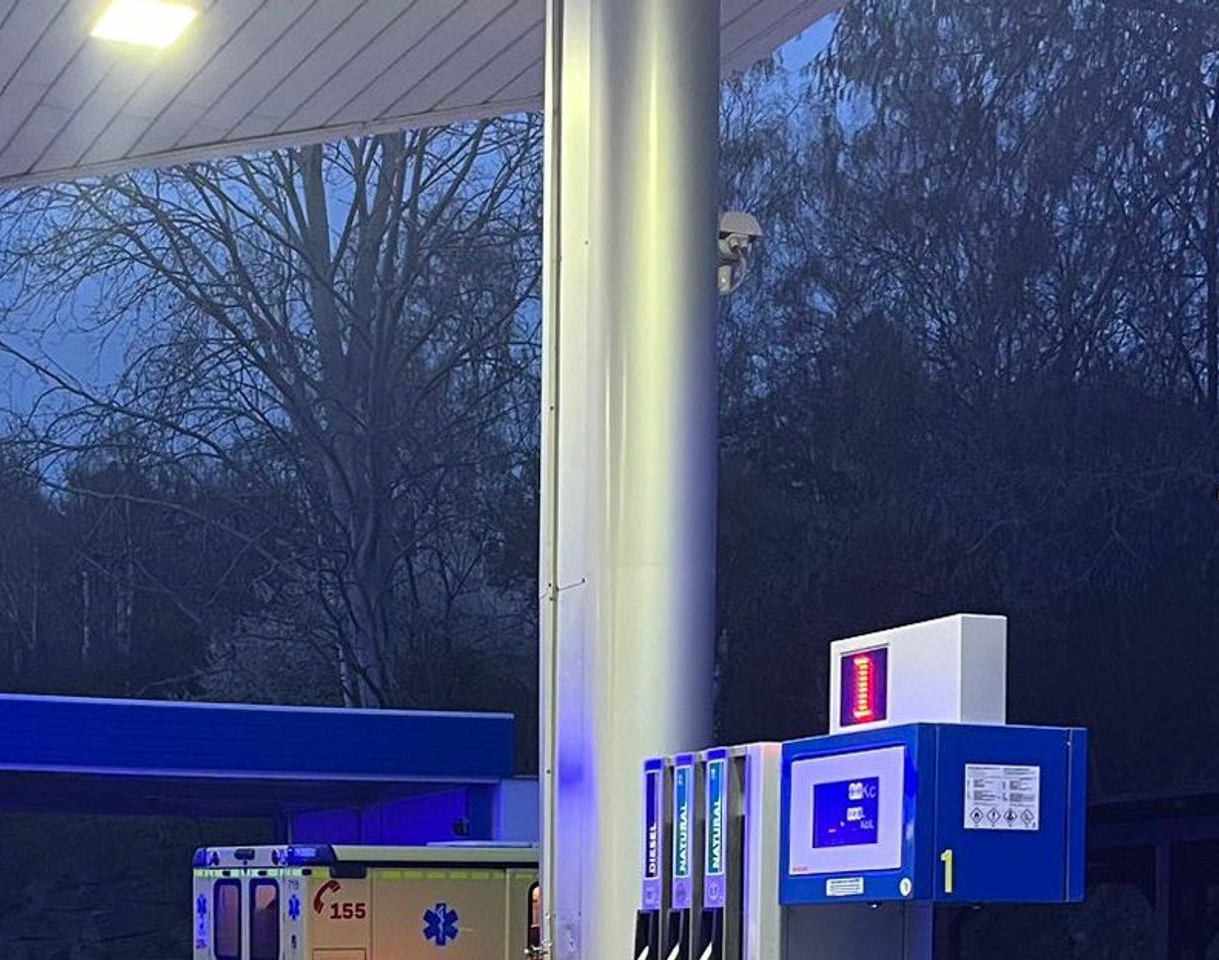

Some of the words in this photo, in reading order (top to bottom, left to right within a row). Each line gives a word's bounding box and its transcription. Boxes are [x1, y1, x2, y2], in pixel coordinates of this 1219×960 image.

[649, 822, 657, 874] DIESEL
[679, 801, 688, 872] NATURAL
[712, 797, 721, 869] NATURAL
[940, 849, 953, 894] 1
[330, 902, 366, 919] 155
